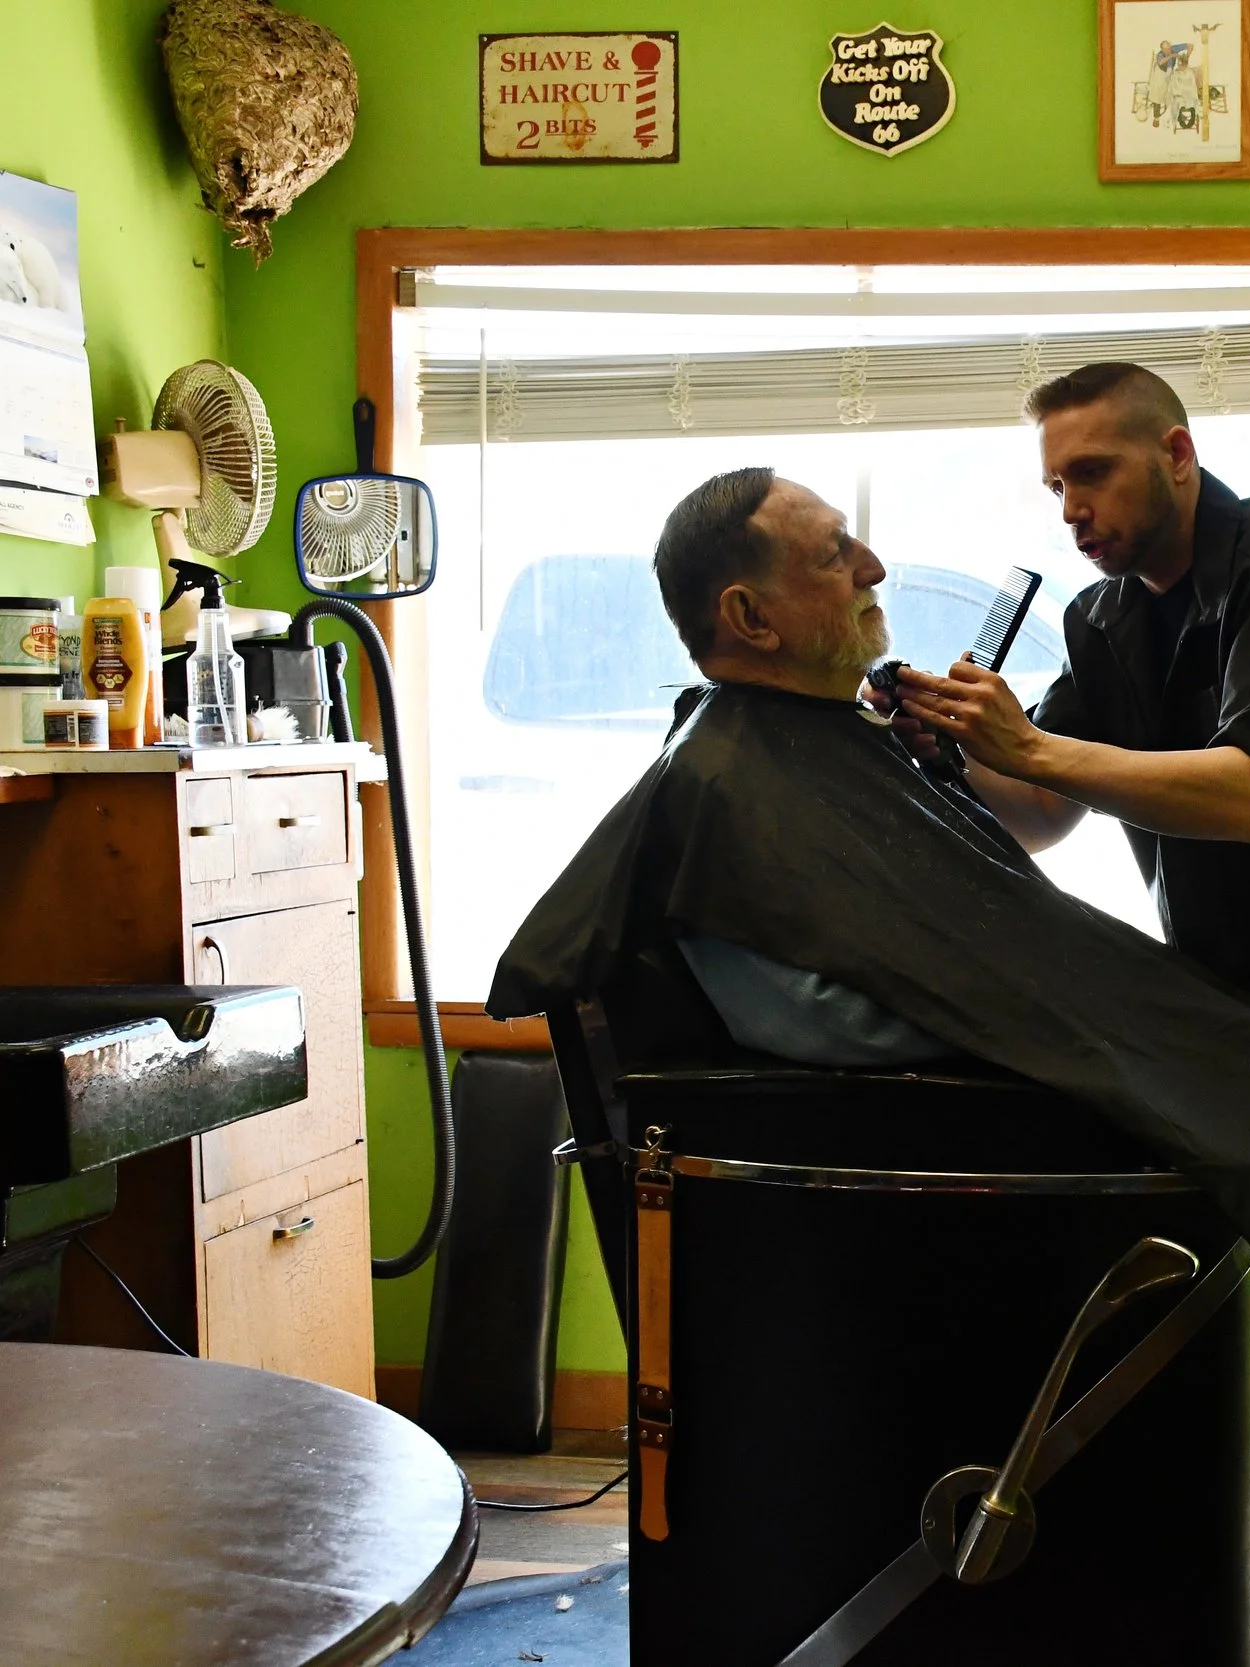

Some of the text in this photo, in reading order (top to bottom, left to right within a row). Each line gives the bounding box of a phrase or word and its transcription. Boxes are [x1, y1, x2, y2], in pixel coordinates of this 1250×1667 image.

[837, 36, 932, 60] Get Your
[500, 50, 621, 72] SHAVE &
[830, 57, 929, 84] Kicks Off
[499, 83, 631, 104] HAIRCUT
[869, 83, 902, 103] On
[854, 101, 920, 124] Route
[516, 119, 597, 150] 2 BITS
[872, 122, 901, 144] 66
[95, 630, 120, 638] Whole
[95, 637, 122, 646] Blends
